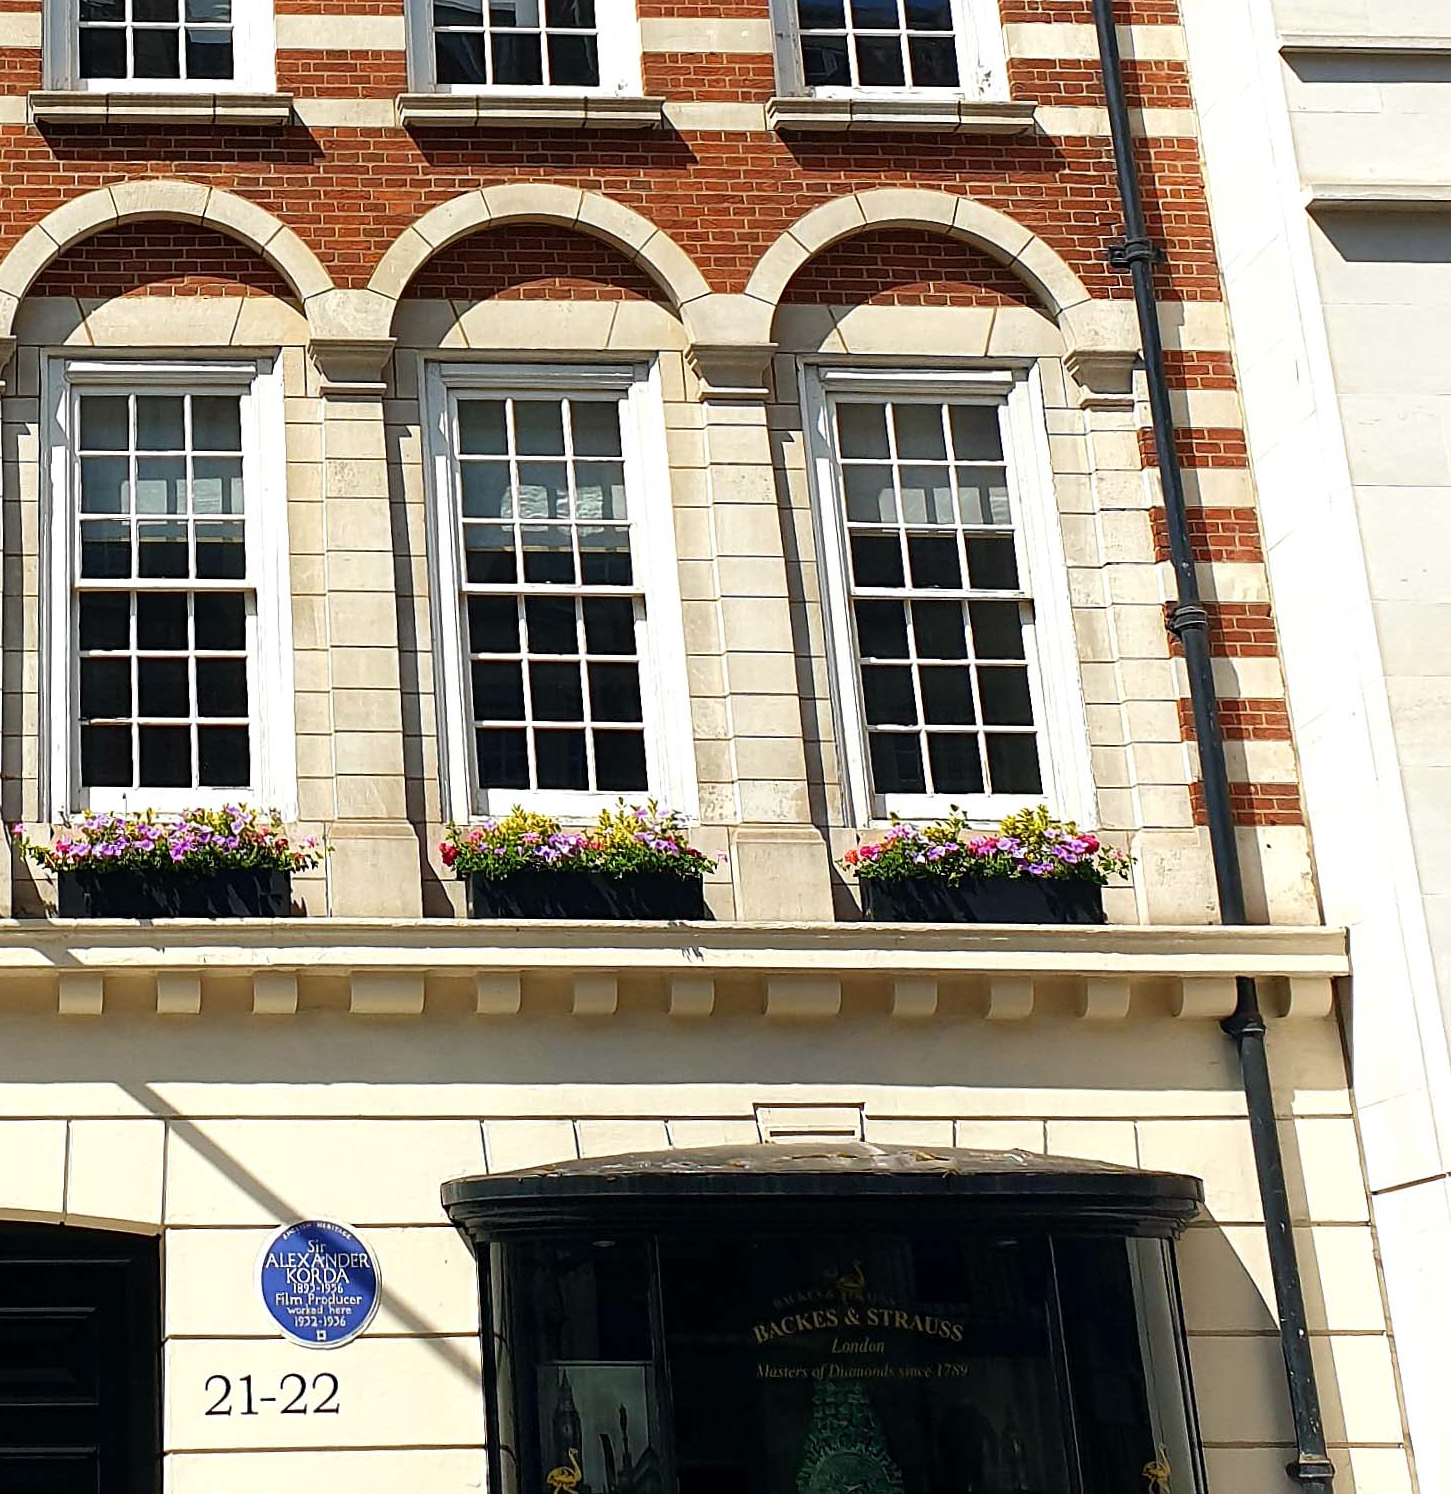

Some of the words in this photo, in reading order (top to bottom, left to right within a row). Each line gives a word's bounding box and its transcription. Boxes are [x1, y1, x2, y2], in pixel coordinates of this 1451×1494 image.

[316, 1222, 352, 1240] HERITAGE
[308, 1240, 326, 1253] Sir
[266, 1253, 370, 1267] ALEXANDER
[286, 1268, 349, 1284] KORDA
[276, 1292, 303, 1305] Film
[308, 1292, 362, 1305] Producer
[287, 1305, 323, 1315] worked
[329, 1305, 352, 1315] here
[294, 1316, 346, 1327] 1932-1936
[752, 1307, 838, 1344] BACKES
[844, 1307, 860, 1326] &
[867, 1307, 964, 1342] STRAUSS
[832, 1337, 885, 1354] London
[756, 1363, 808, 1379] Masters
[812, 1363, 827, 1381] of
[829, 1363, 894, 1379] Diamonds
[899, 1364, 932, 1379] since
[937, 1363, 968, 1378] 1789
[205, 1372, 340, 1416] 21-22
